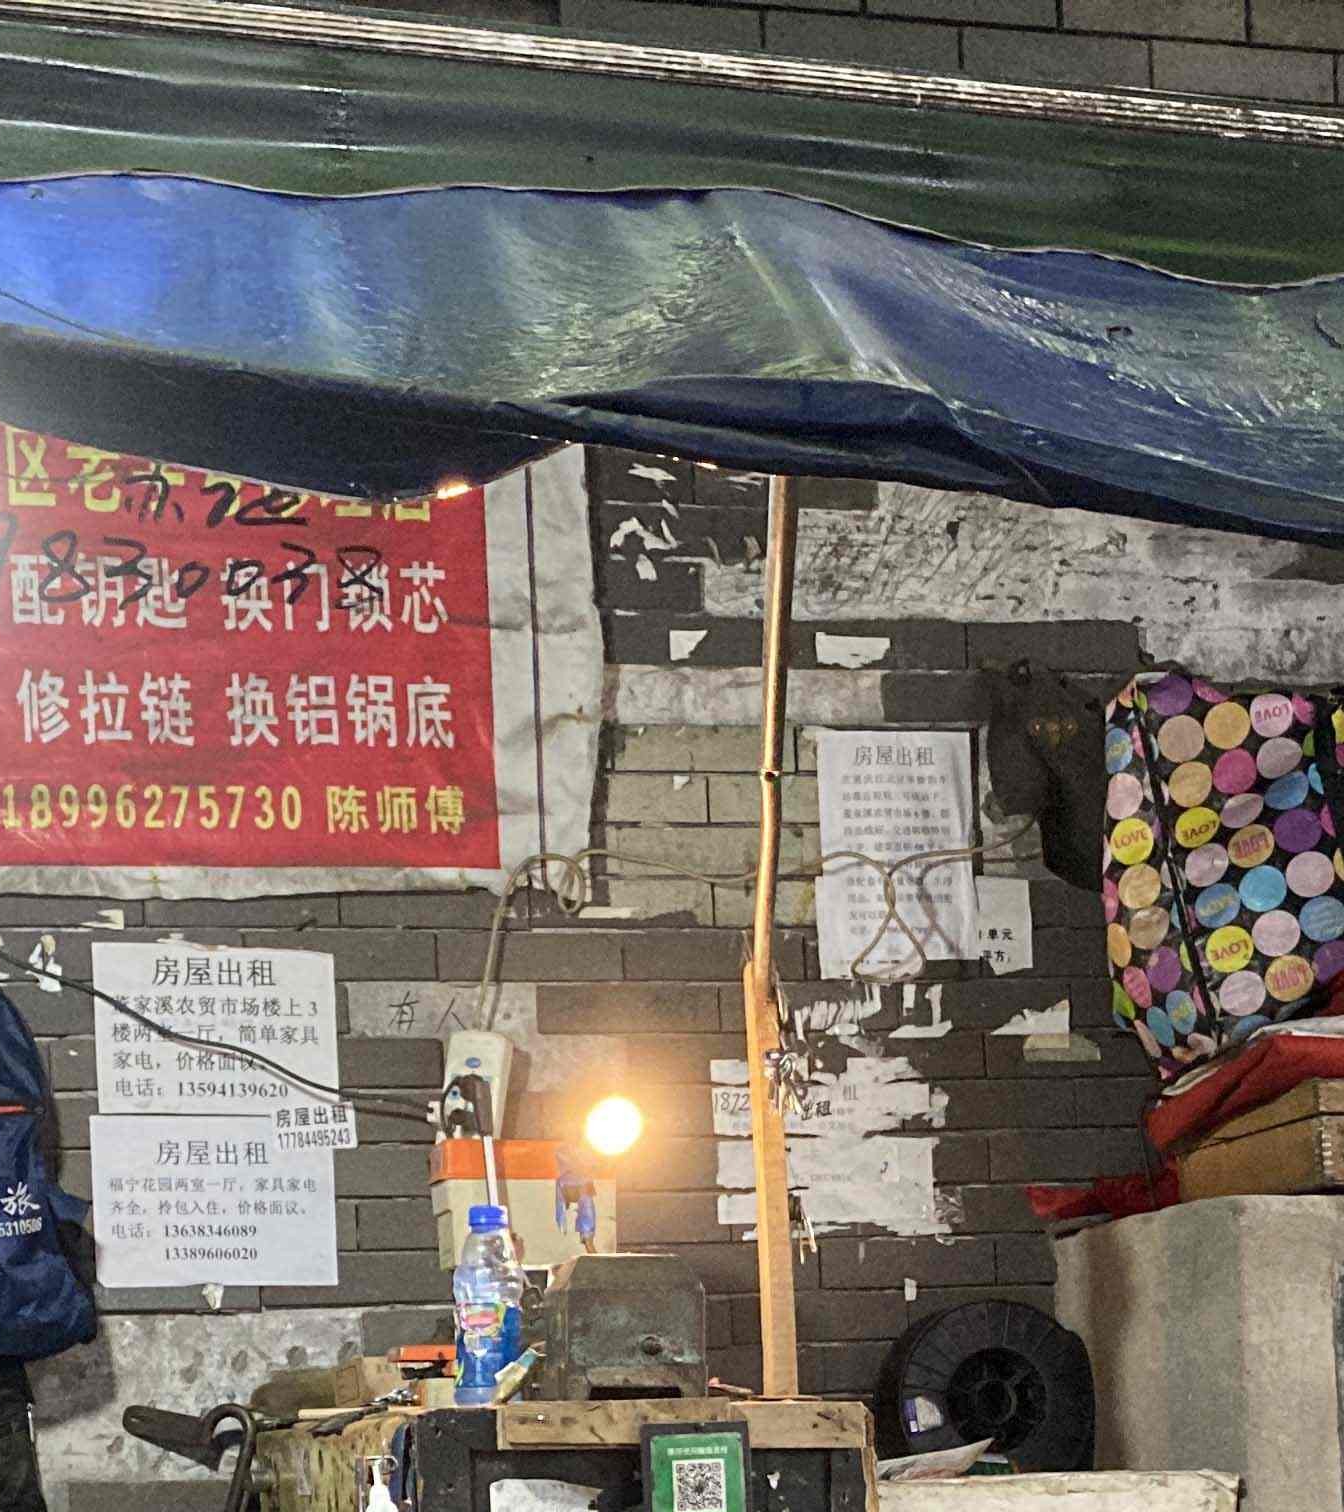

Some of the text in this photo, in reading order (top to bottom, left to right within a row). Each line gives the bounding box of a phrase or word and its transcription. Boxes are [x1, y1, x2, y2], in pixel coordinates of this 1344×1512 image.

[10, 551, 188, 630] 配钥匙
[220, 556, 447, 634] 换门锁芯
[16, 667, 196, 746] 修拉链
[225, 672, 456, 750] 换铝锅底
[854, 746, 936, 767] 房屋出租
[1, 783, 304, 832] 18996275730
[325, 785, 467, 836] 陈师傅
[1113, 828, 1149, 849] LOVE
[1210, 938, 1249, 961] LOVE
[153, 957, 277, 987] 房屋出租
[178, 1081, 289, 1099] 13594139620
[275, 1104, 349, 1128] 房屋出租
[277, 1127, 352, 1150] 17784495243
[154, 1140, 270, 1166] 房屋出租
[163, 1223, 257, 1238] 13638346089
[164, 1246, 258, 1261] 13389606020
